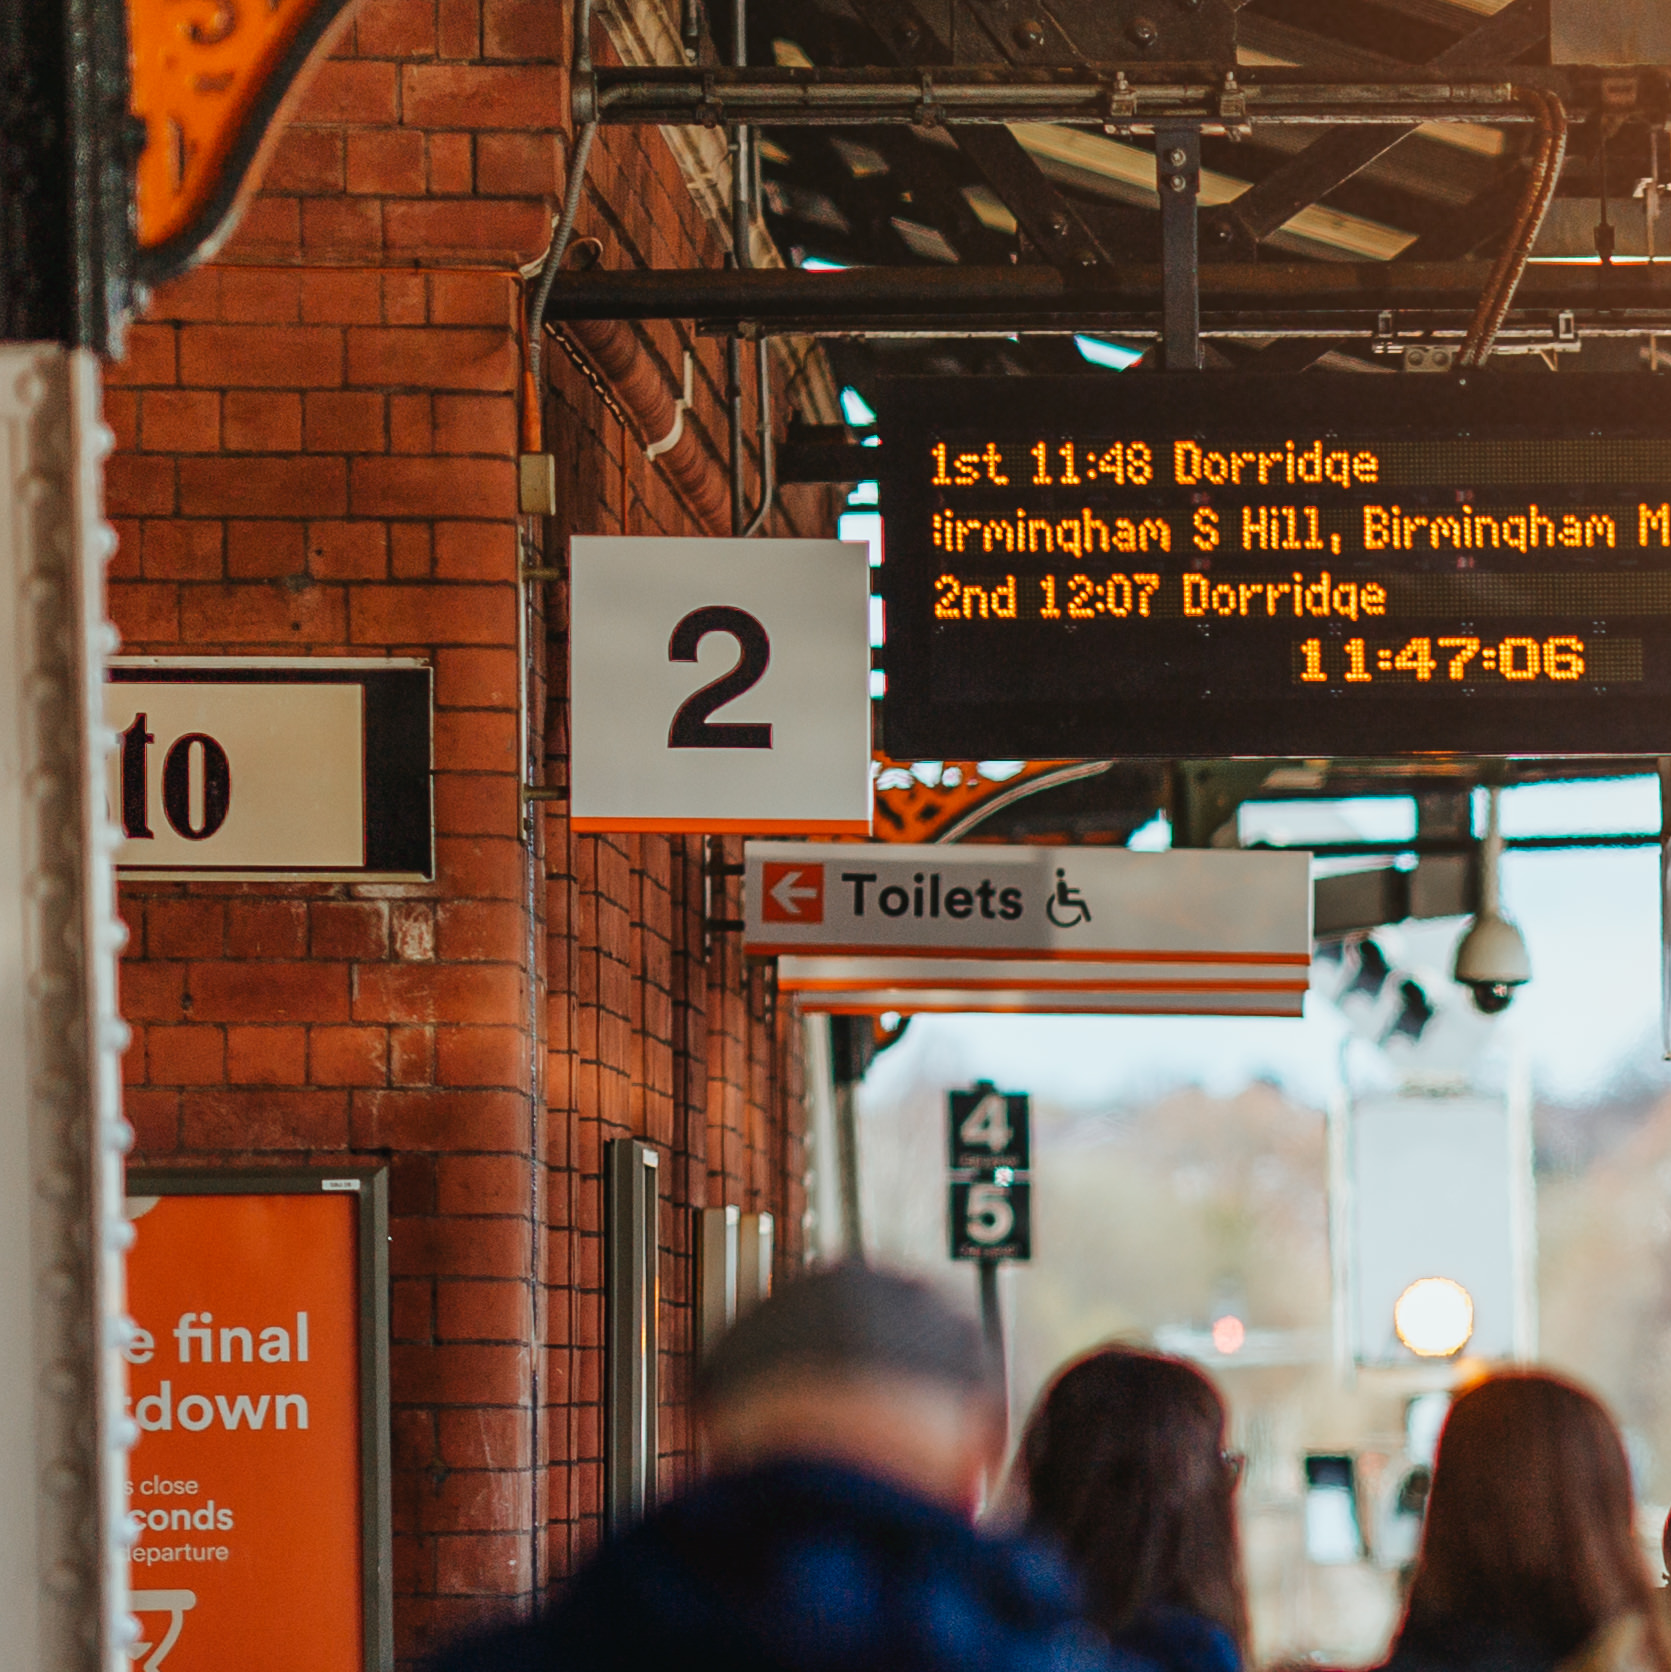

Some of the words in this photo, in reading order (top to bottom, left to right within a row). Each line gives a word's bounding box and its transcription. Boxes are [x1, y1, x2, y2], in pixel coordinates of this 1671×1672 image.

[931, 441, 1009, 486] 1st
[1031, 441, 1153, 485] 11:48
[1173, 440, 1379, 489] Dorridge
[1193, 505, 1220, 550] S
[1242, 504, 1341, 555] Hill,
[1363, 504, 1616, 554] Birmingham
[934, 573, 1017, 619] 2nd
[1040, 573, 1160, 619] 12:07
[1182, 571, 1387, 621] Dorridge
[668, 604, 773, 750] 2
[1300, 635, 1585, 682] 11:47:06
[841, 872, 1023, 920] Toilets
[960, 1094, 1014, 1151] 4
[966, 1182, 1016, 1245] 5
[173, 1311, 309, 1363] final
[125, 1380, 309, 1431] down
[140, 1475, 198, 1495] close
